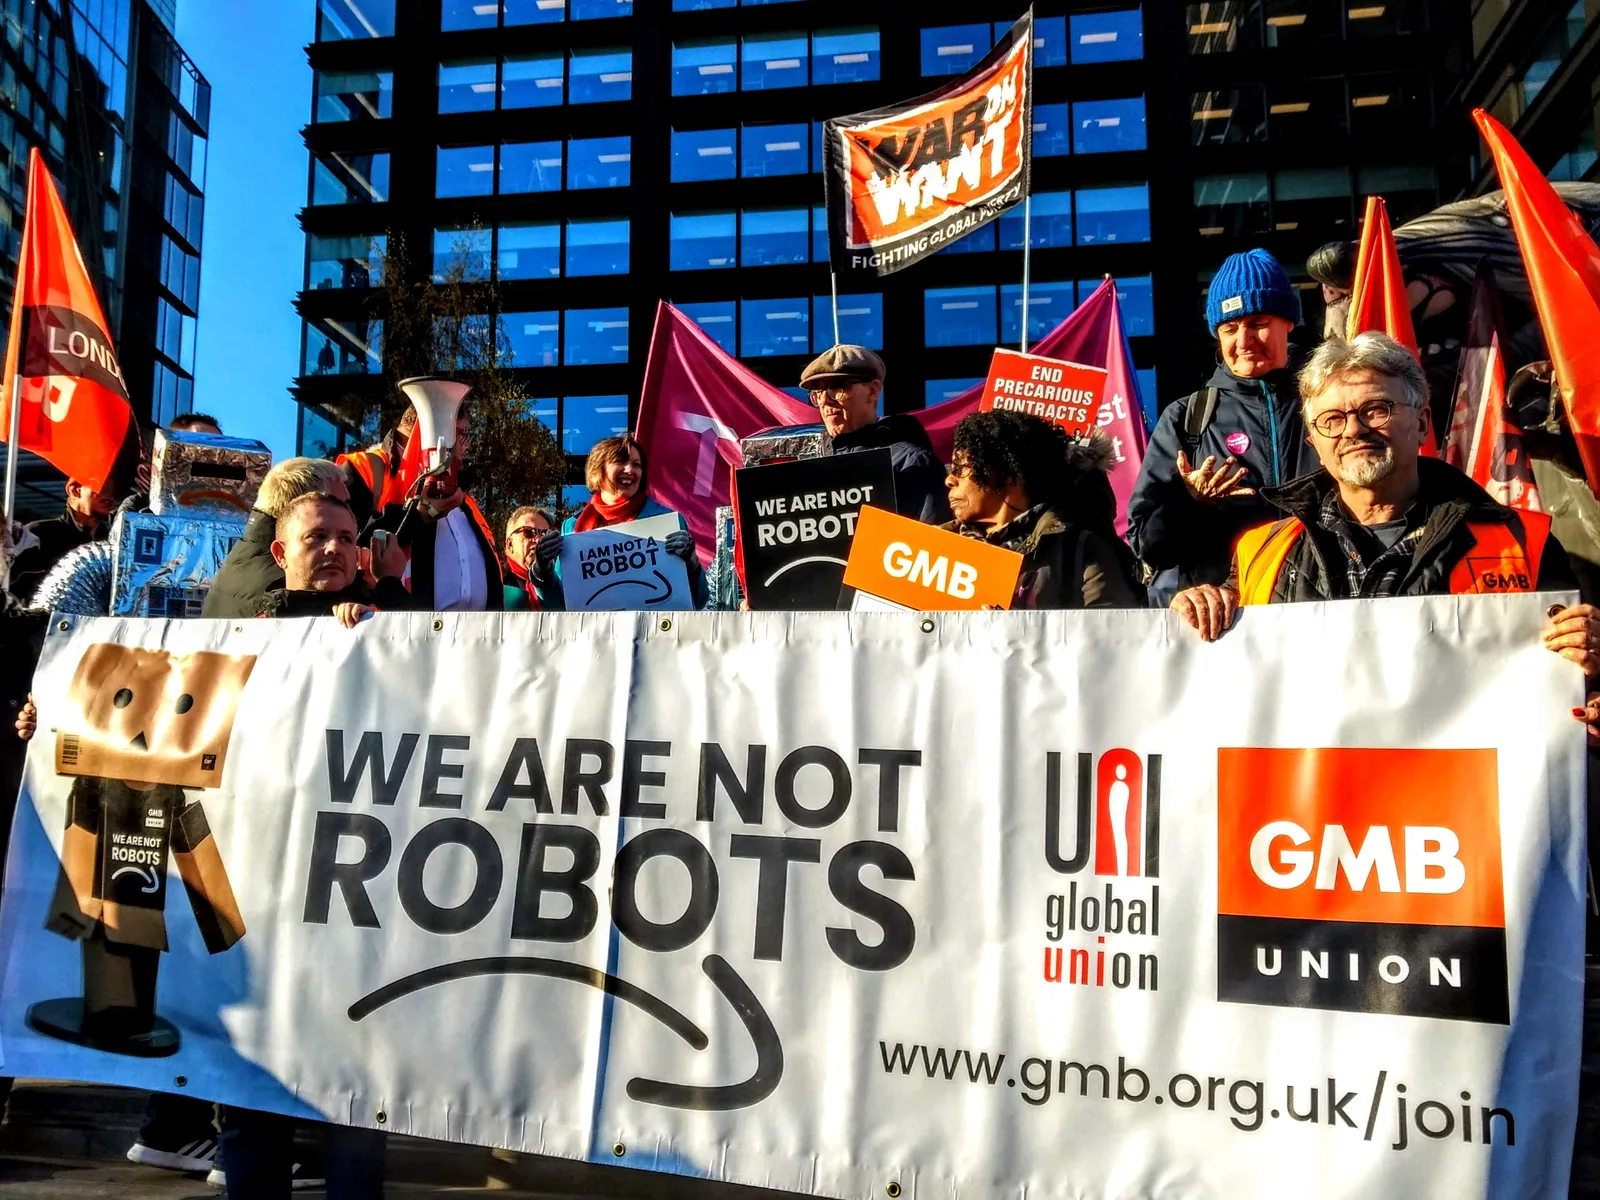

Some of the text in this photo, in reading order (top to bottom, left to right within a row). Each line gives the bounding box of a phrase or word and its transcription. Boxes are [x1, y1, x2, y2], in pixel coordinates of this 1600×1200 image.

[855, 65, 1018, 179] WAR ON
[866, 102, 1016, 226] WANT
[851, 236, 929, 269] FIGHTING
[929, 214, 978, 246] GLOBAL
[993, 378, 1094, 405] PRECARIOUS
[1031, 365, 1063, 383] END
[992, 396, 1087, 423] CONTRACTS
[755, 486, 874, 517] WE ARE NOT
[580, 536, 658, 561] I AM NOT A
[581, 548, 659, 580] ROBOT
[882, 541, 978, 600] GMB
[1482, 572, 1529, 589] GMB
[325, 728, 922, 832] WE ARE NOT
[148, 808, 163, 817] GMB
[1045, 747, 1162, 878] UNI
[111, 847, 160, 866] ROBOTS
[112, 833, 162, 848] WE ARE NOT
[1249, 821, 1466, 894] GMB
[302, 810, 917, 972] ROBOTS
[1046, 881, 1160, 942] global
[1044, 936, 1159, 992] union
[1256, 947, 1462, 988] UNION
[879, 1040, 1515, 1151] www.gmb.org.uk/join
